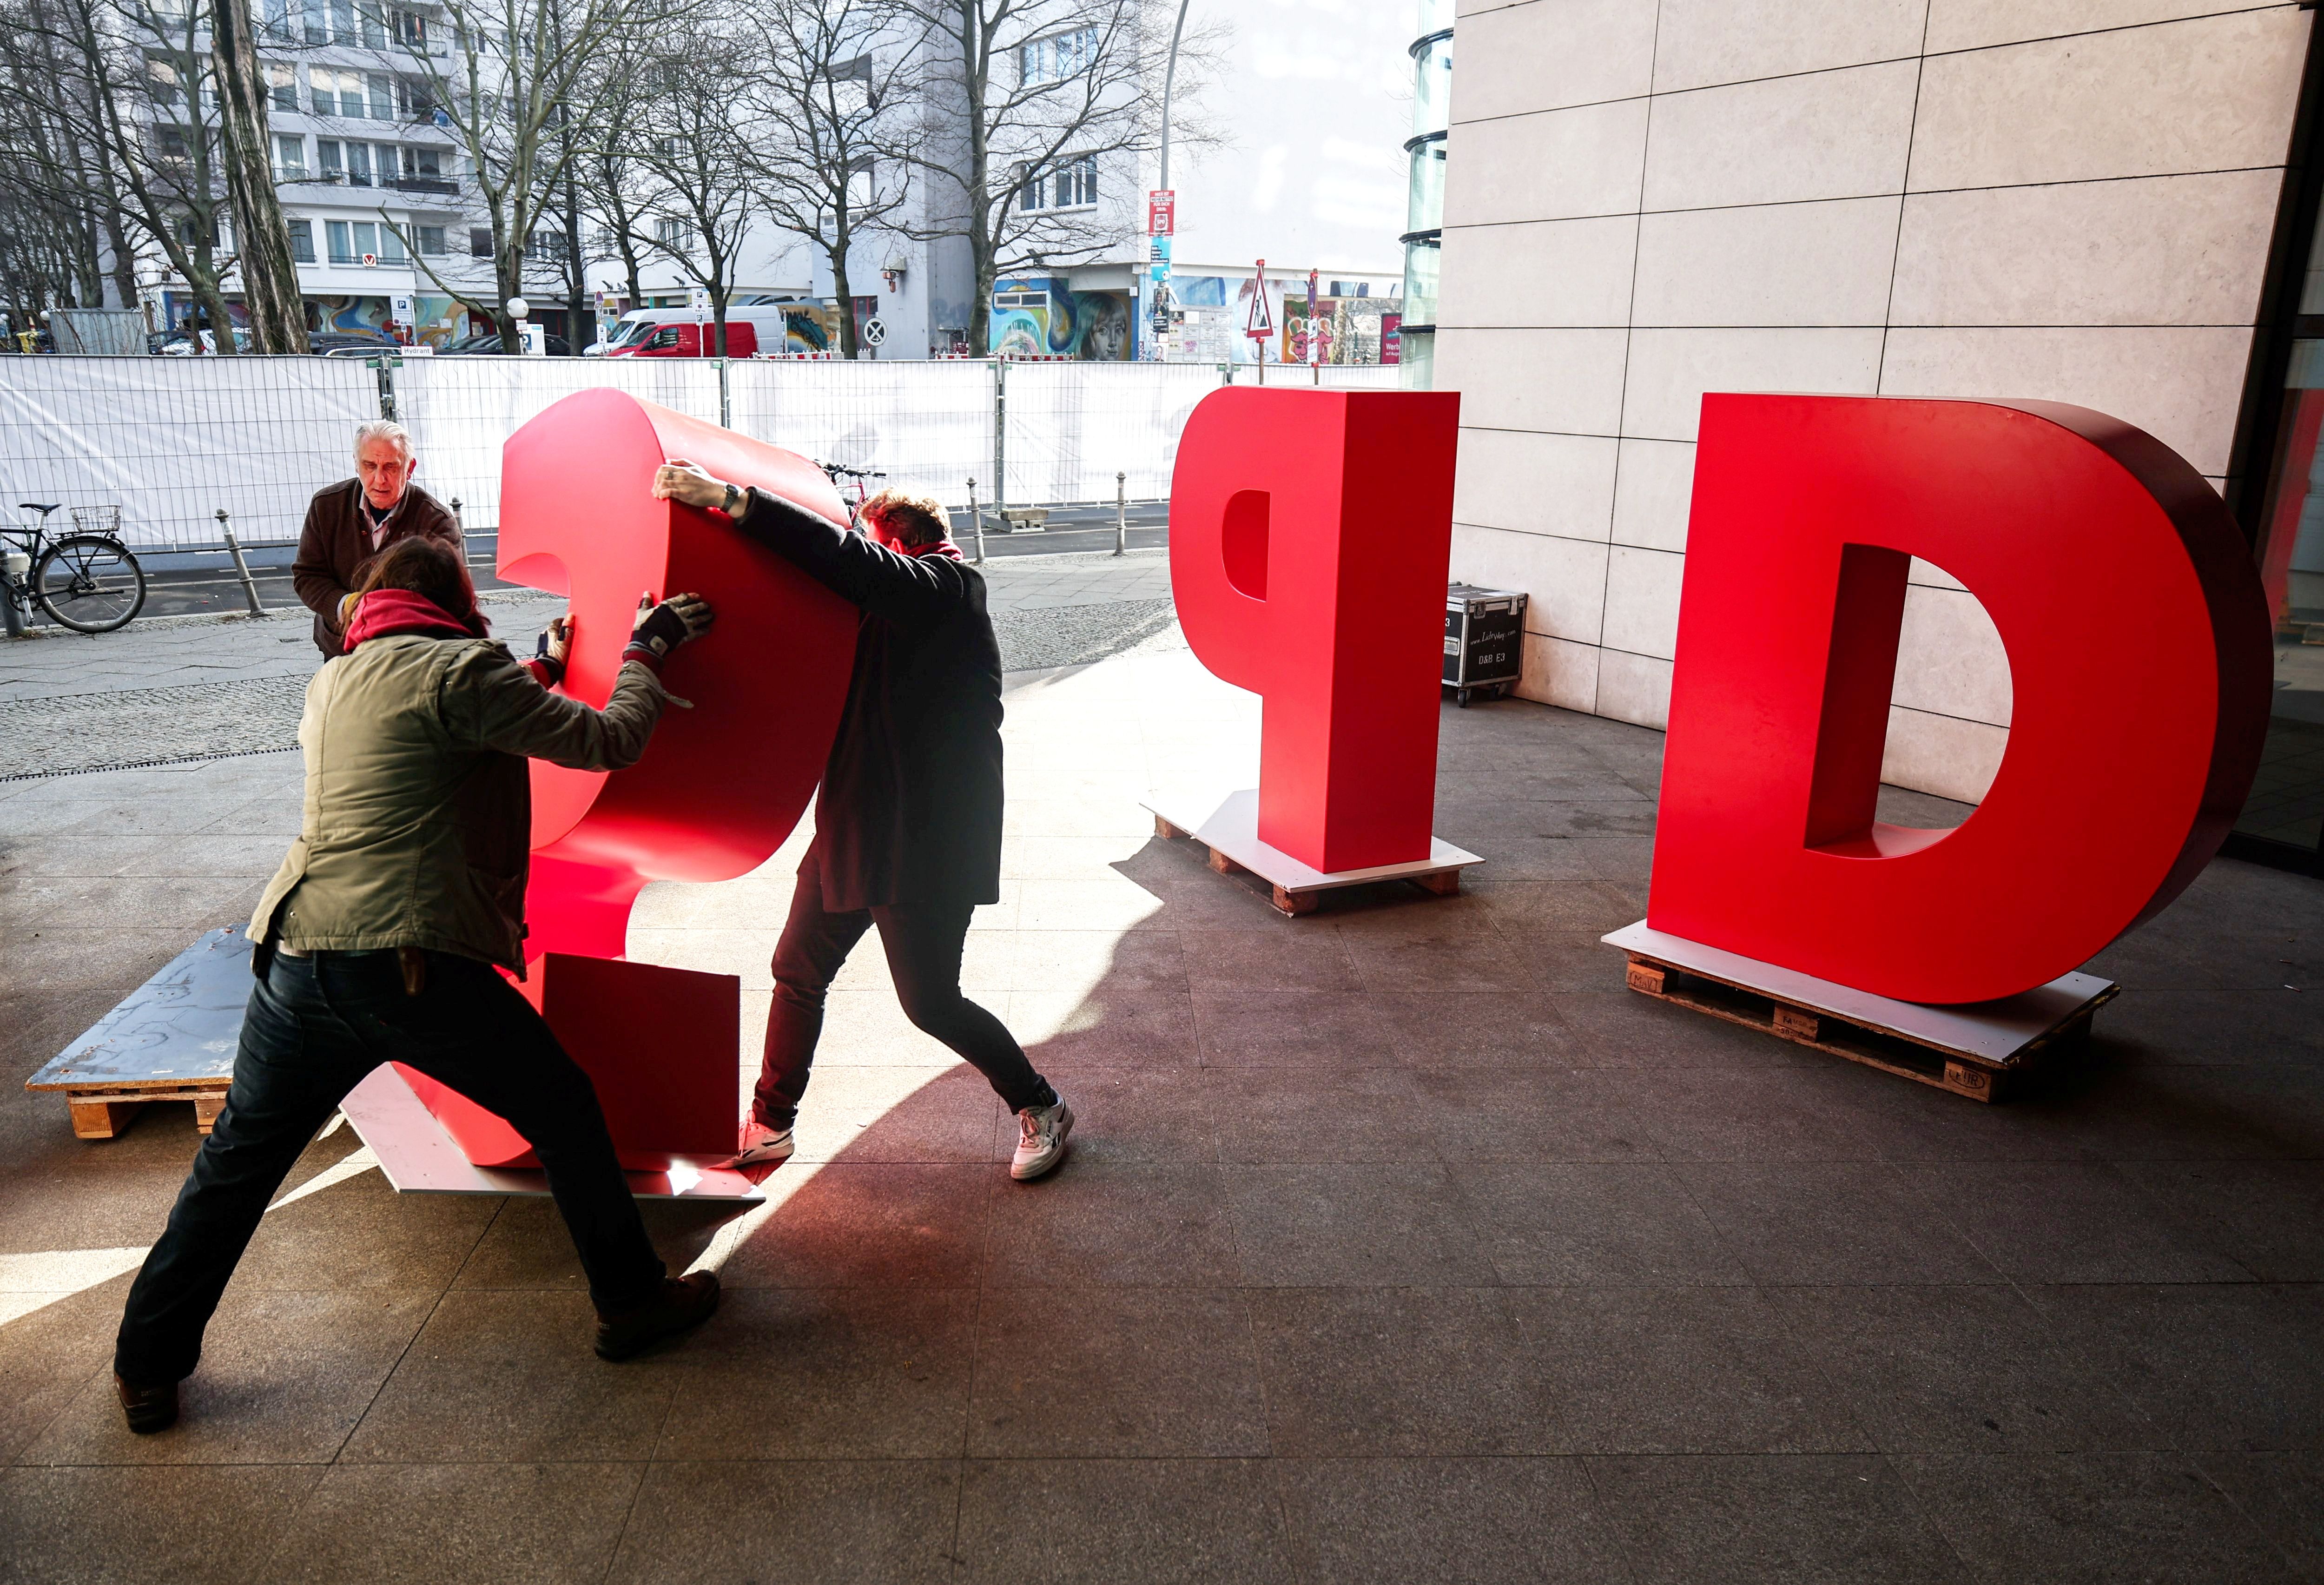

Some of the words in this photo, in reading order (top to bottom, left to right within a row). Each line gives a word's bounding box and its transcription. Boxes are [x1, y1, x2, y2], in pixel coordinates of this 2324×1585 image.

[1479, 654, 1493, 665] D&B
[1496, 653, 1505, 662] E3
[1648, 392, 2274, 1006] D
